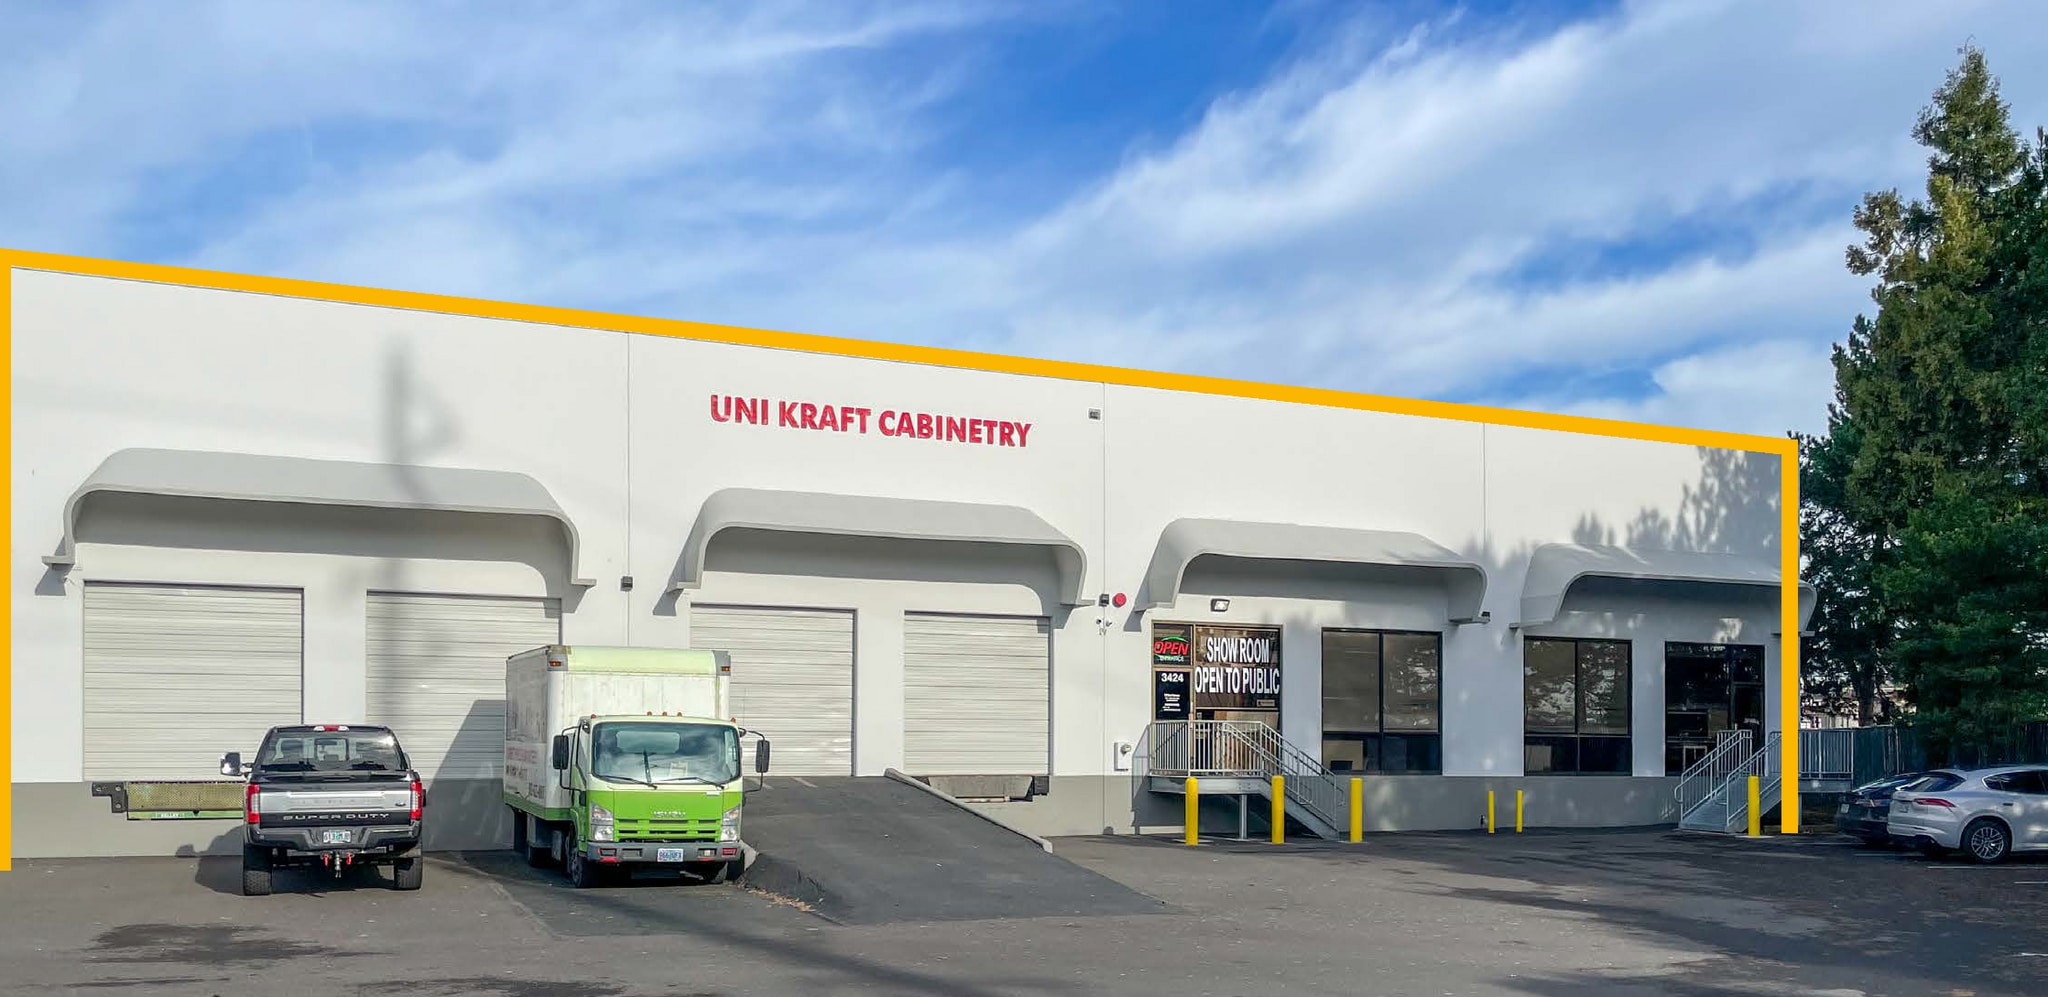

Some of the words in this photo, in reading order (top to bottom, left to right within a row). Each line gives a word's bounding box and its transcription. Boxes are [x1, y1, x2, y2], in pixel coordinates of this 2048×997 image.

[710, 394, 769, 425] UNI
[779, 400, 871, 434] KRAFT
[878, 410, 1032, 447] CABINETRY
[1154, 641, 1189, 655] OPEN
[1207, 637, 1239, 663] SHOW
[1240, 638, 1270, 663] ROOM
[1161, 673, 1184, 682] 3424
[1194, 667, 1223, 693] OPEN
[1225, 668, 1240, 694] TO
[1242, 668, 1280, 694] PUBLIC
